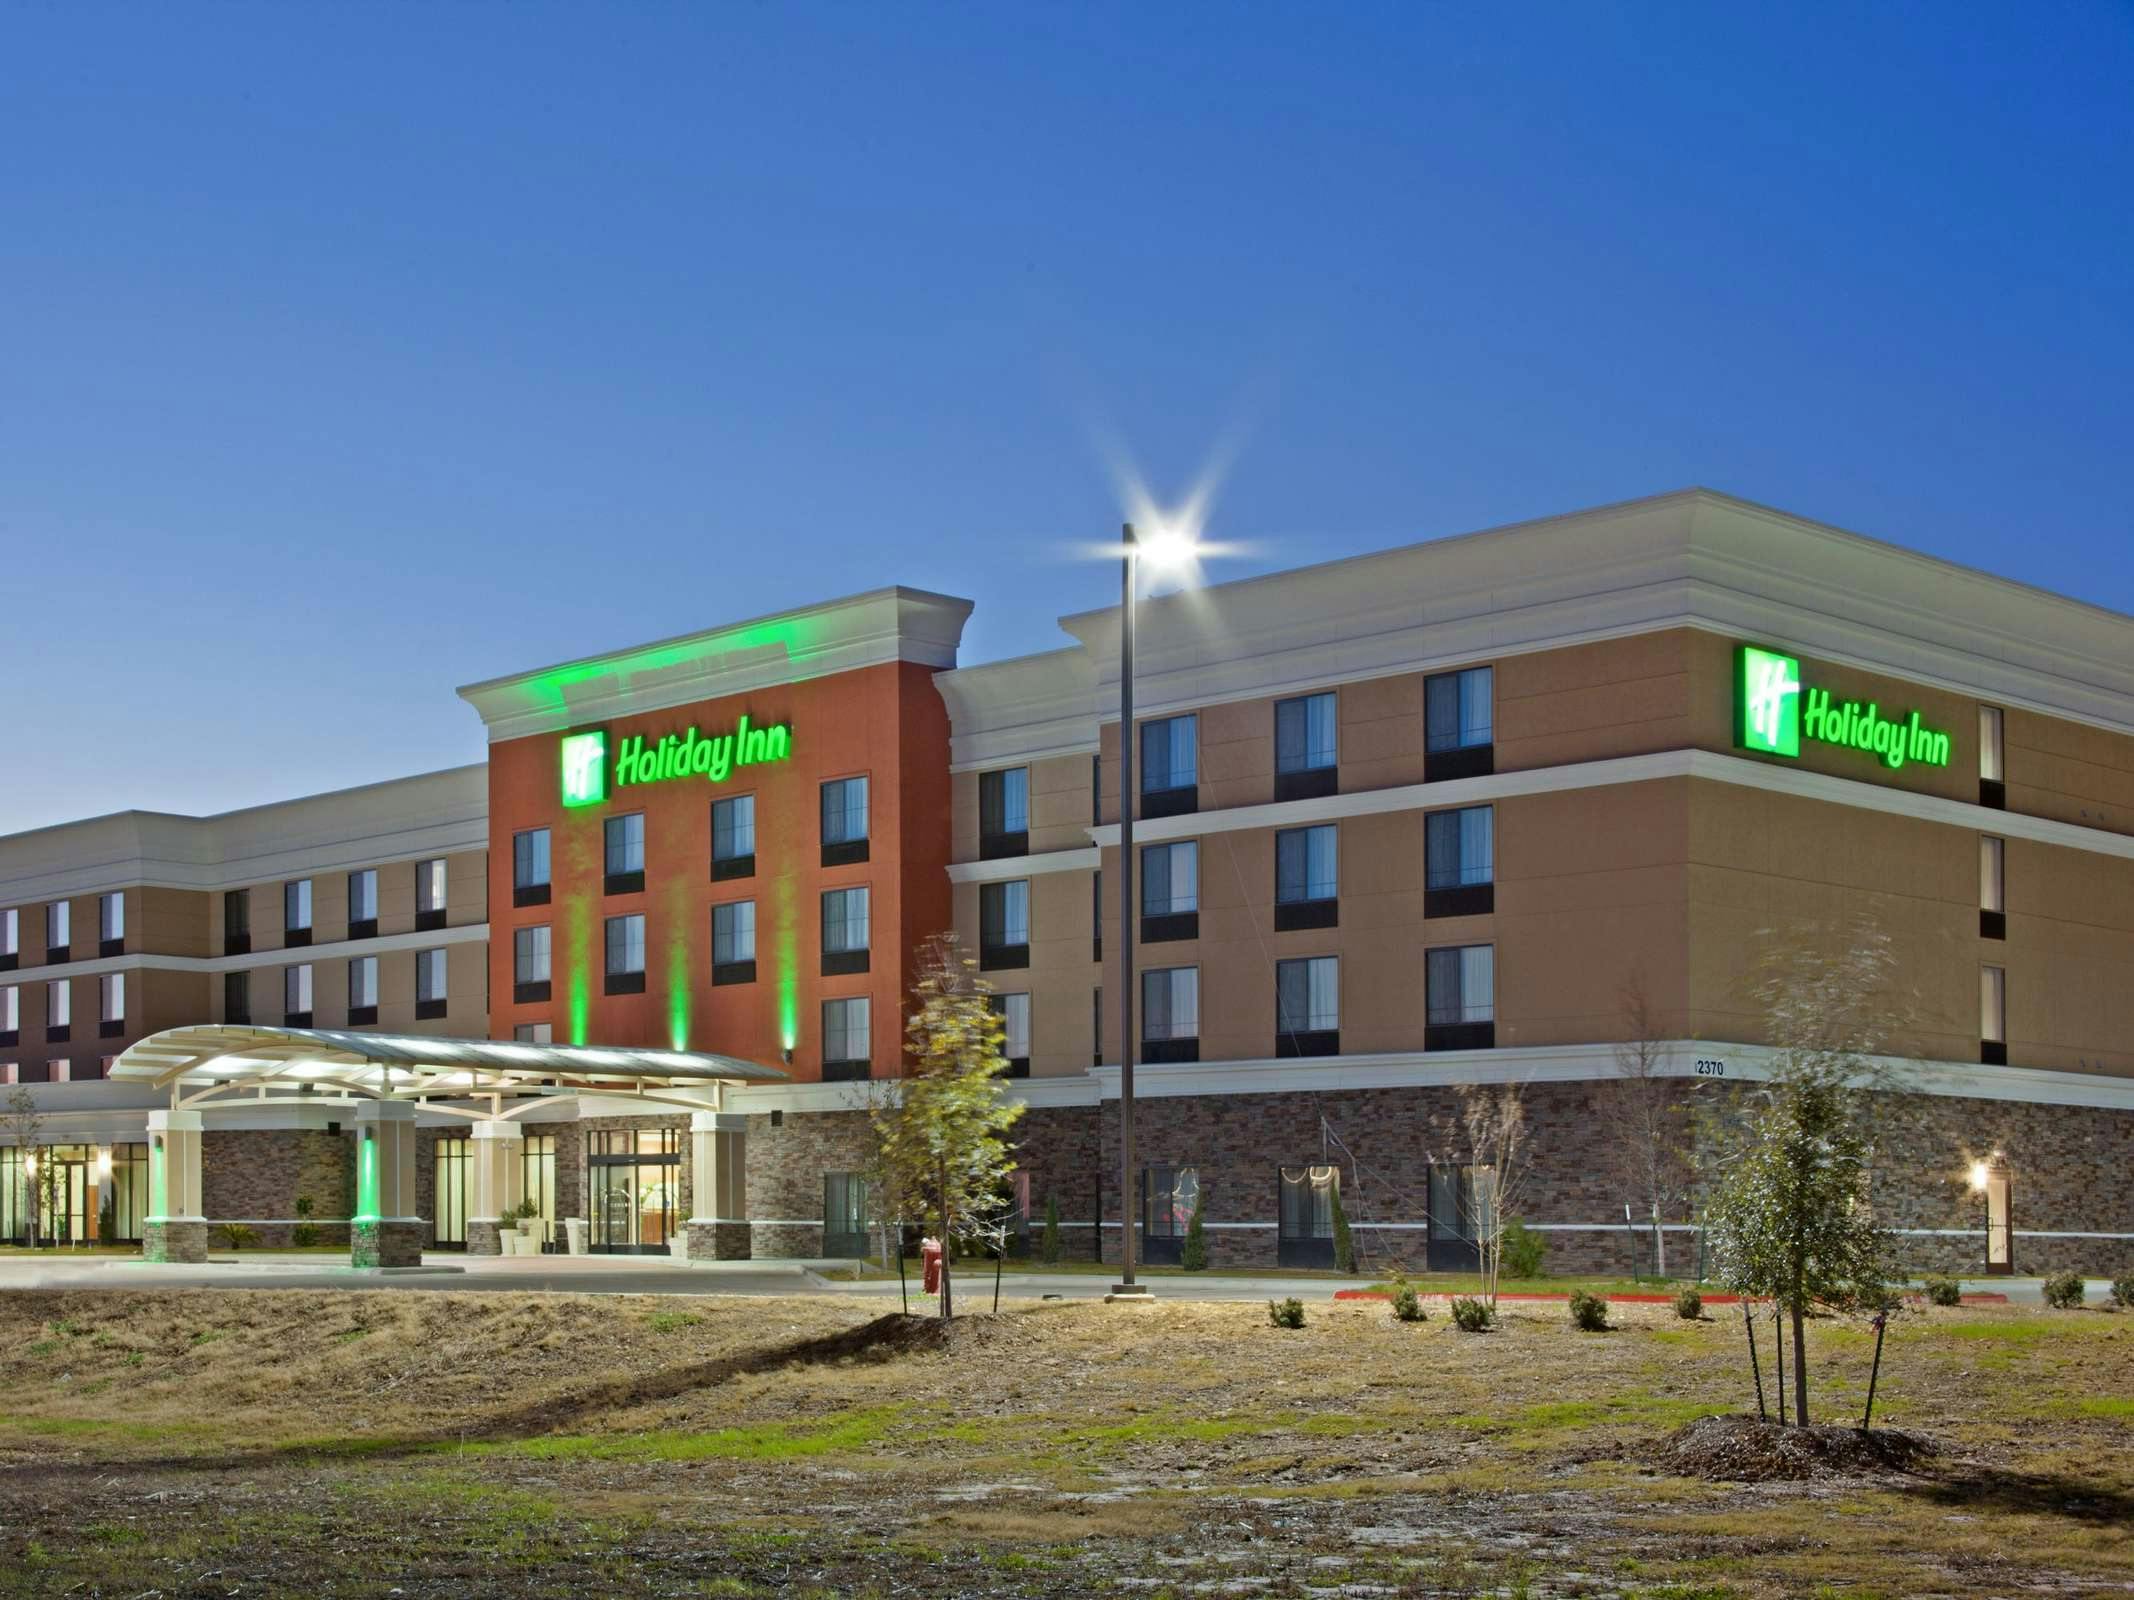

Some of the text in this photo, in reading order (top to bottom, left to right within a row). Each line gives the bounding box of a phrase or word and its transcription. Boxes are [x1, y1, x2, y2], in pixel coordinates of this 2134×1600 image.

[616, 715, 787, 786] Holiday Inn
[1804, 688, 1949, 768] Holiday Inn
[1697, 1060, 1723, 1075] 2370
